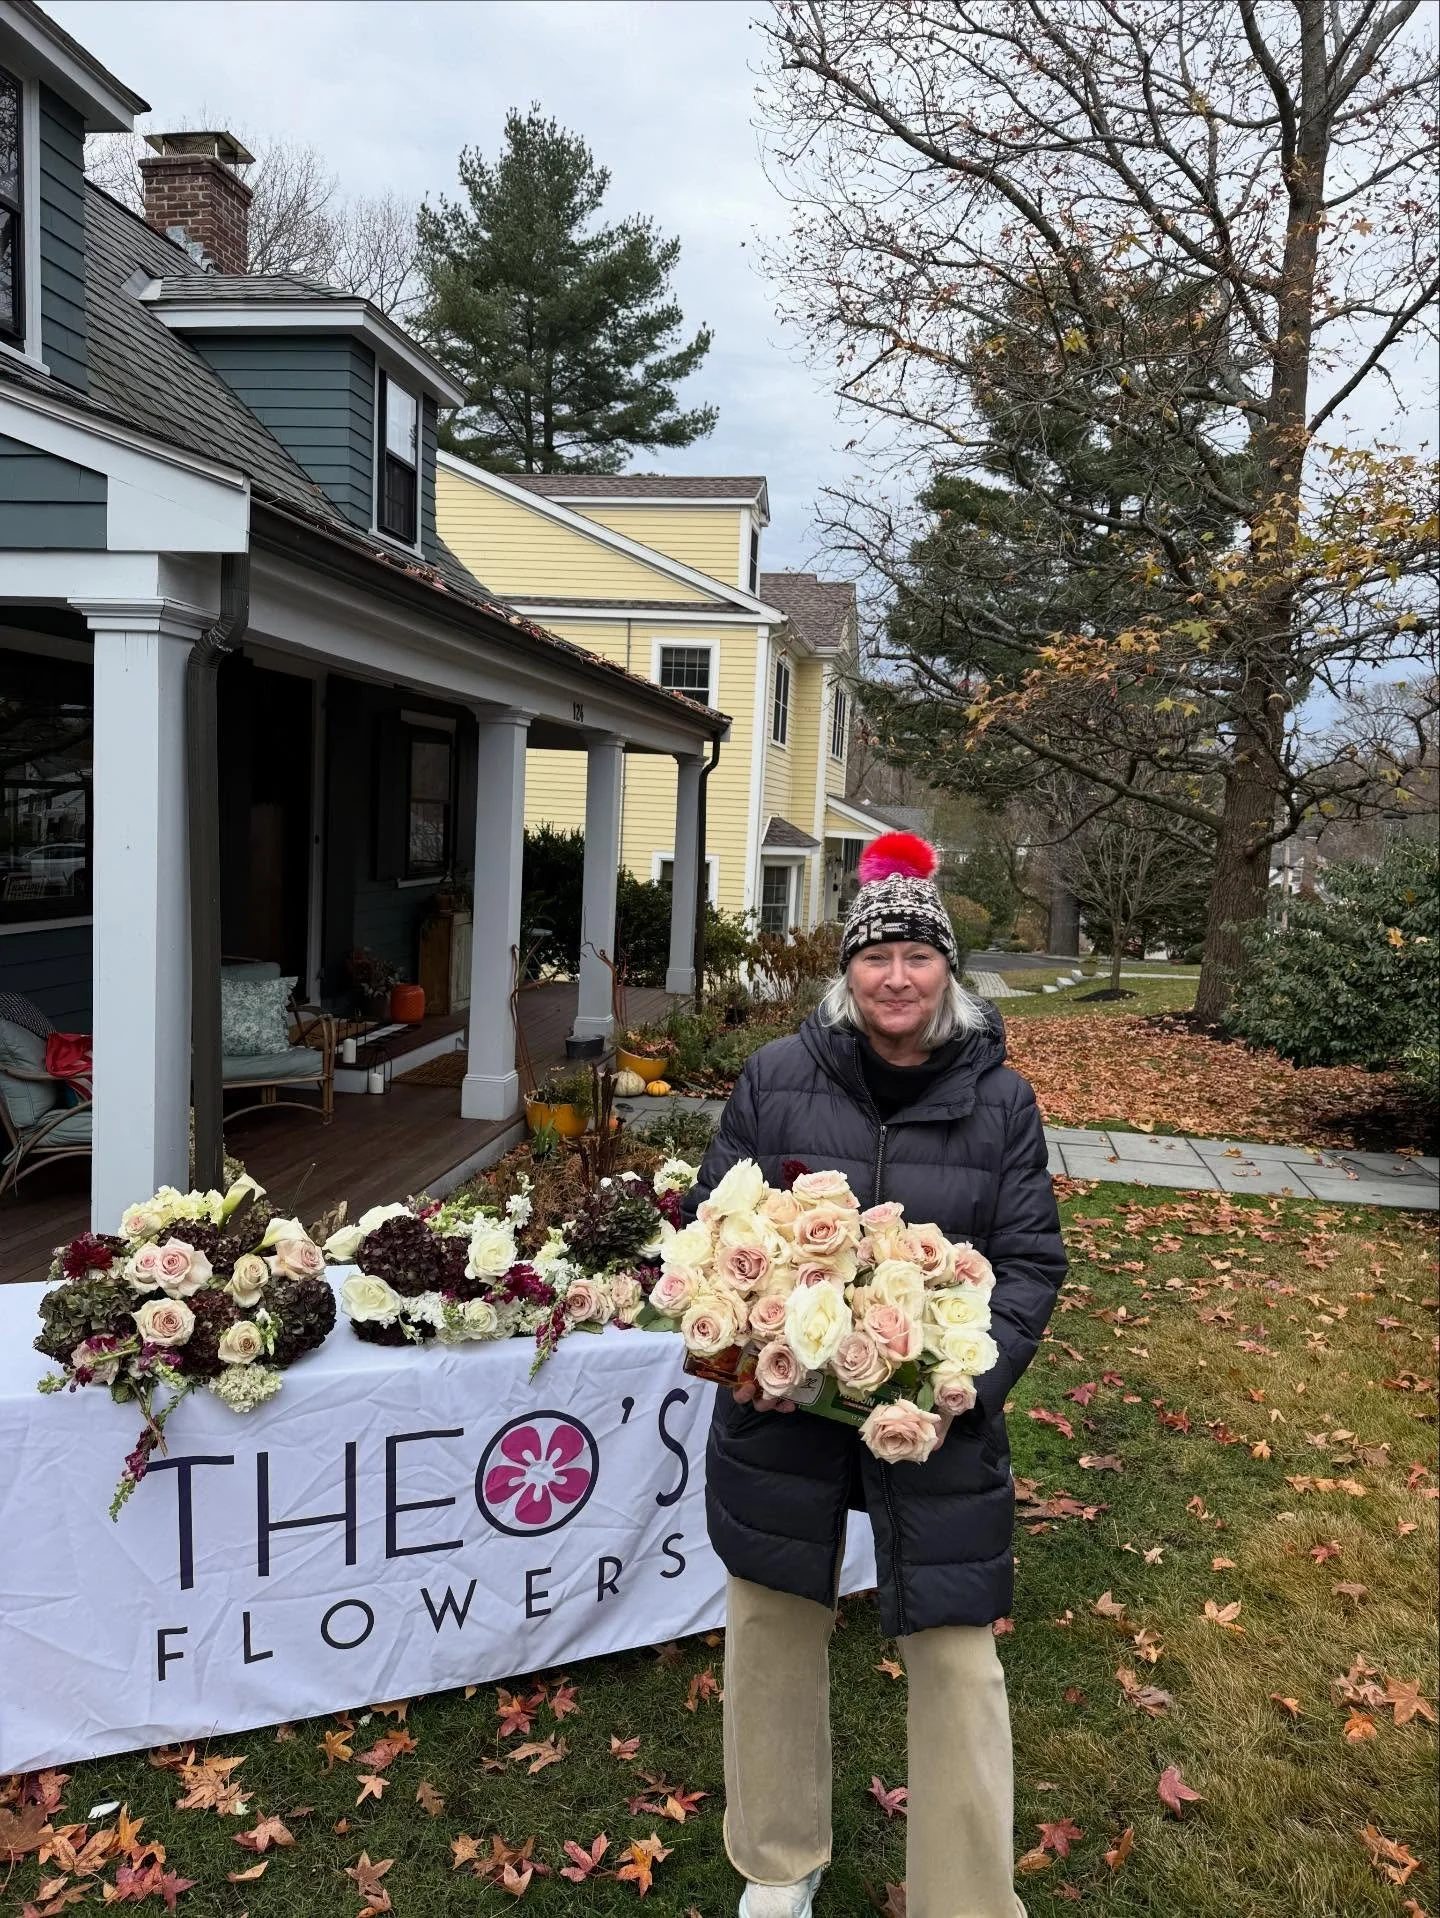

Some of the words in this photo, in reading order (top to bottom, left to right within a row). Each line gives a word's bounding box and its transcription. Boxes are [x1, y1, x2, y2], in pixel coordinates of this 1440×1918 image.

[573, 701, 584, 723] 124
[146, 1388, 689, 1591] THEO'S
[157, 1533, 687, 1681] FLOWERS
